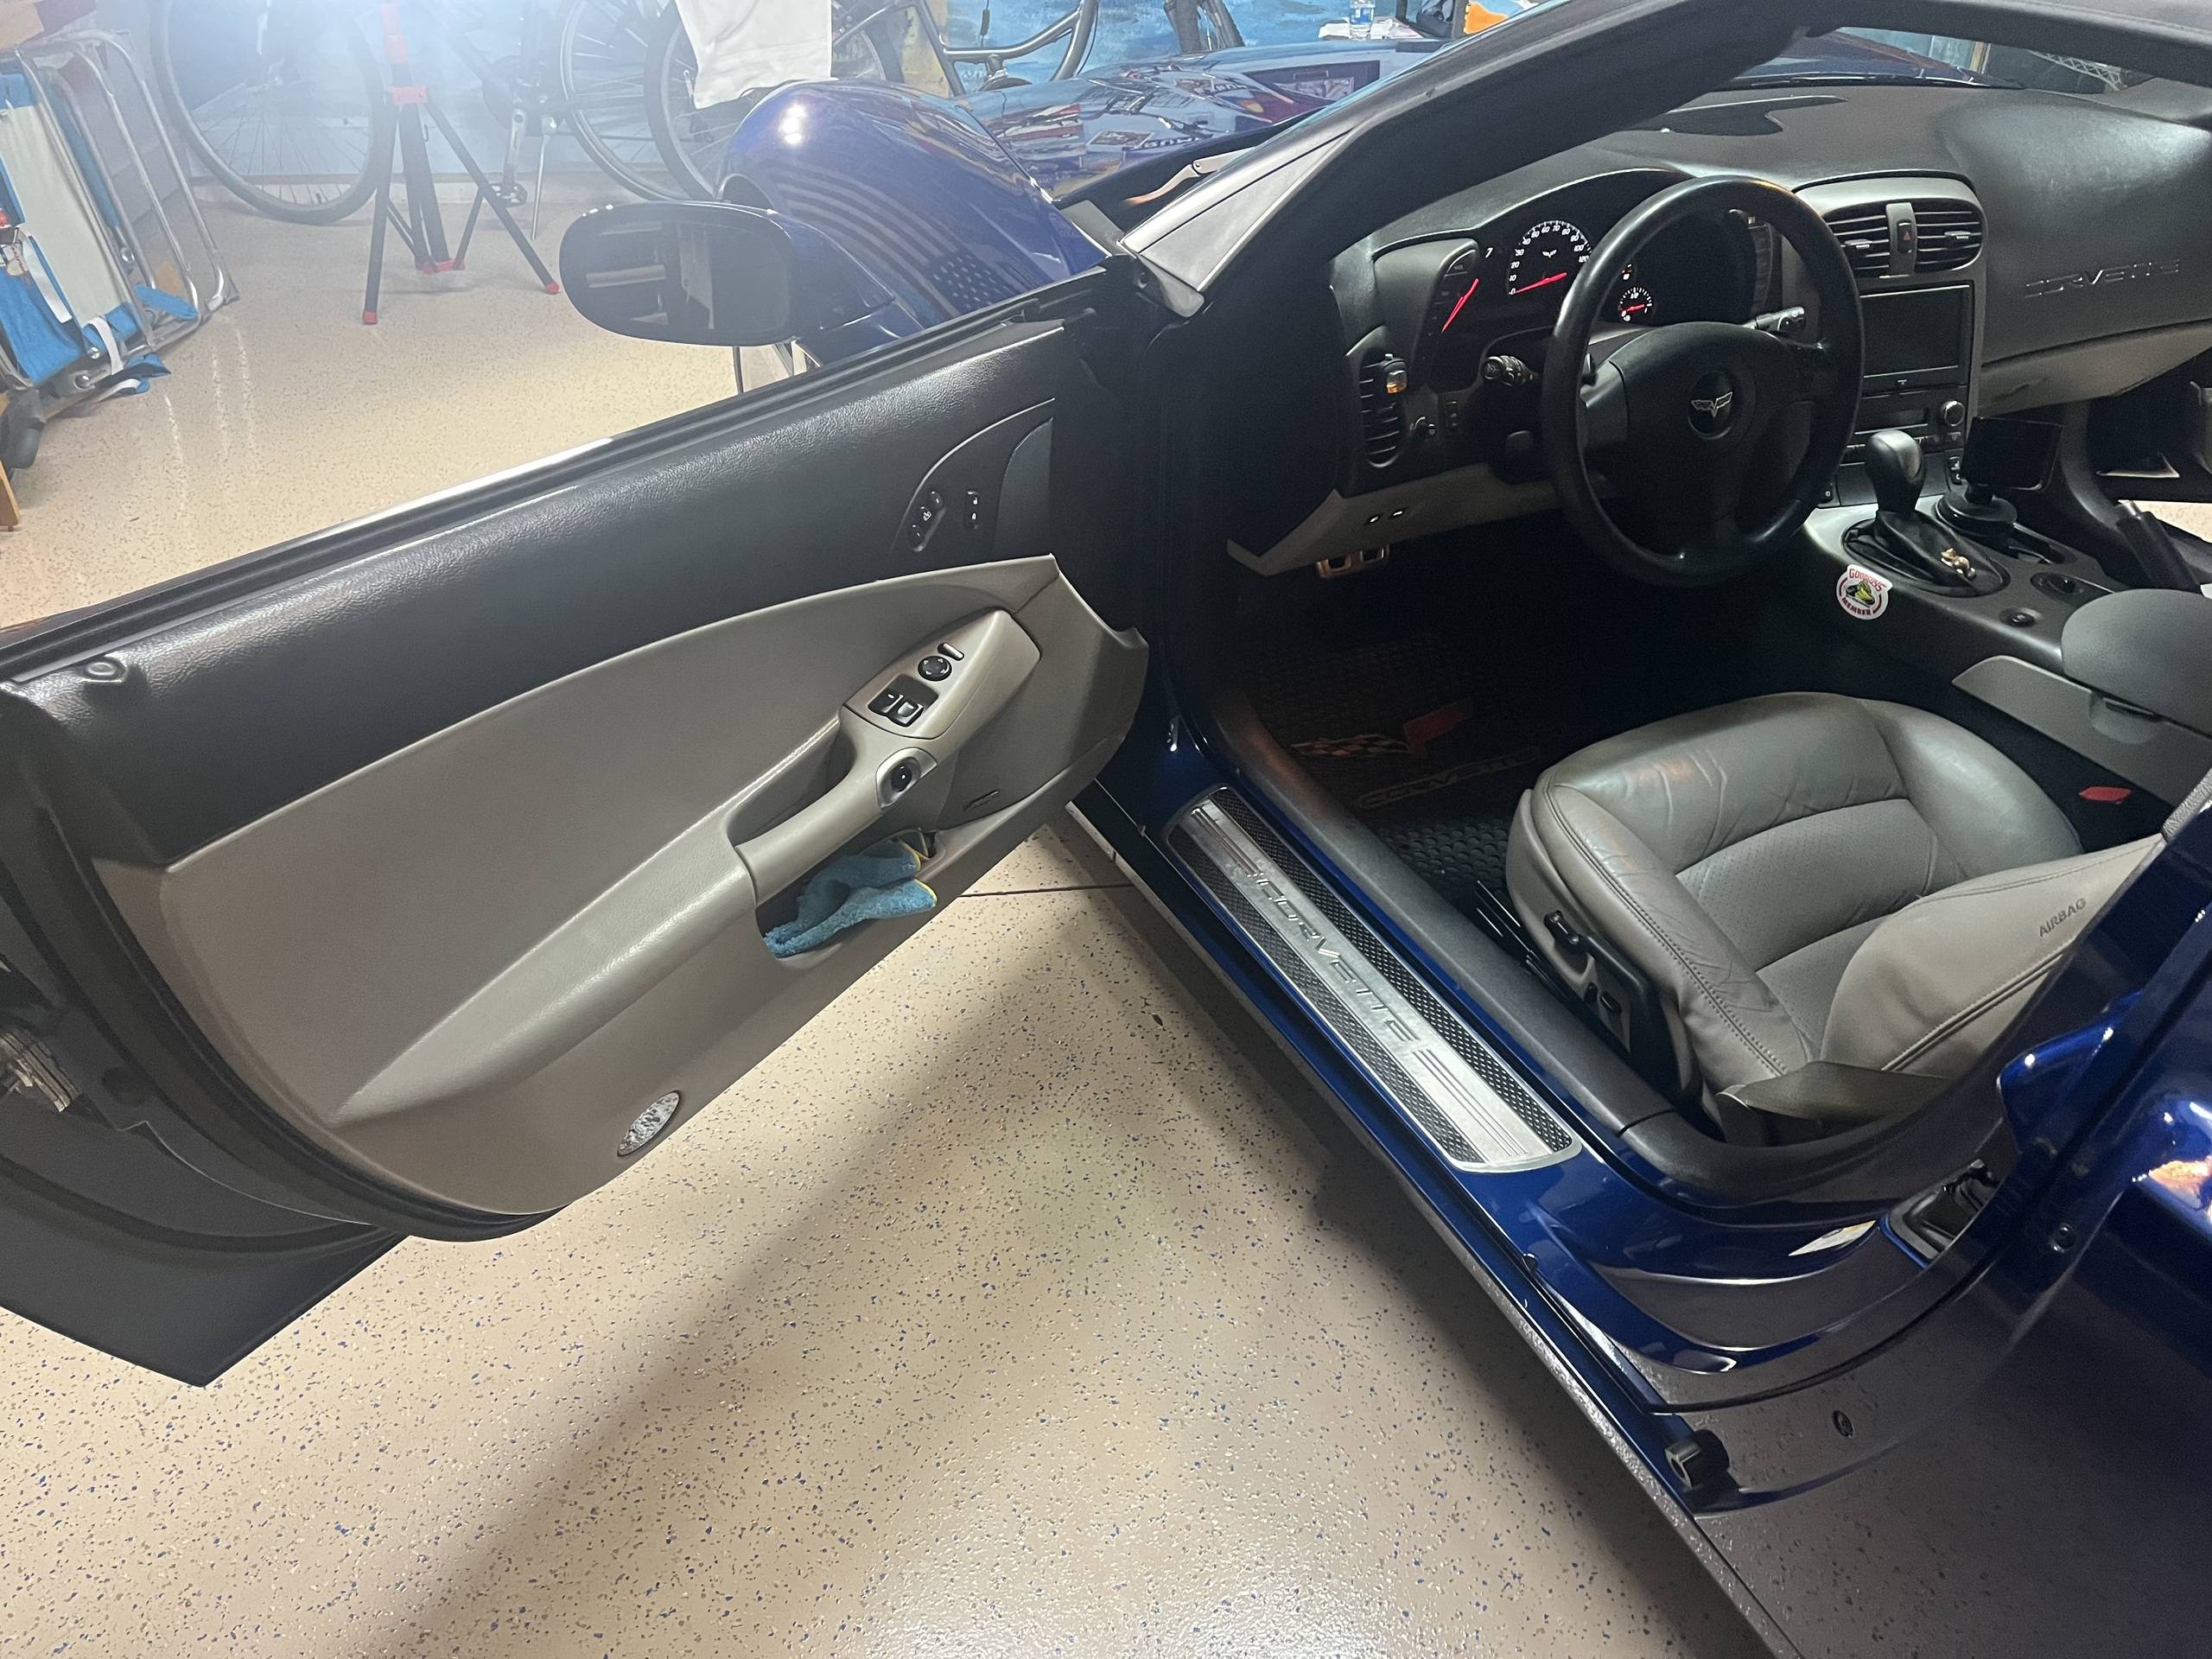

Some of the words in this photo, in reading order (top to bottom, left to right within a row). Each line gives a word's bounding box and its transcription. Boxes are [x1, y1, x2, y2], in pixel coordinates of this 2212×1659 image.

[2024, 258, 2181, 299] CORVETTE
[1841, 597, 1872, 616] MEMBER
[2039, 898, 2086, 938] AIRBAG
[1255, 878, 1421, 1042] CORVETTE
